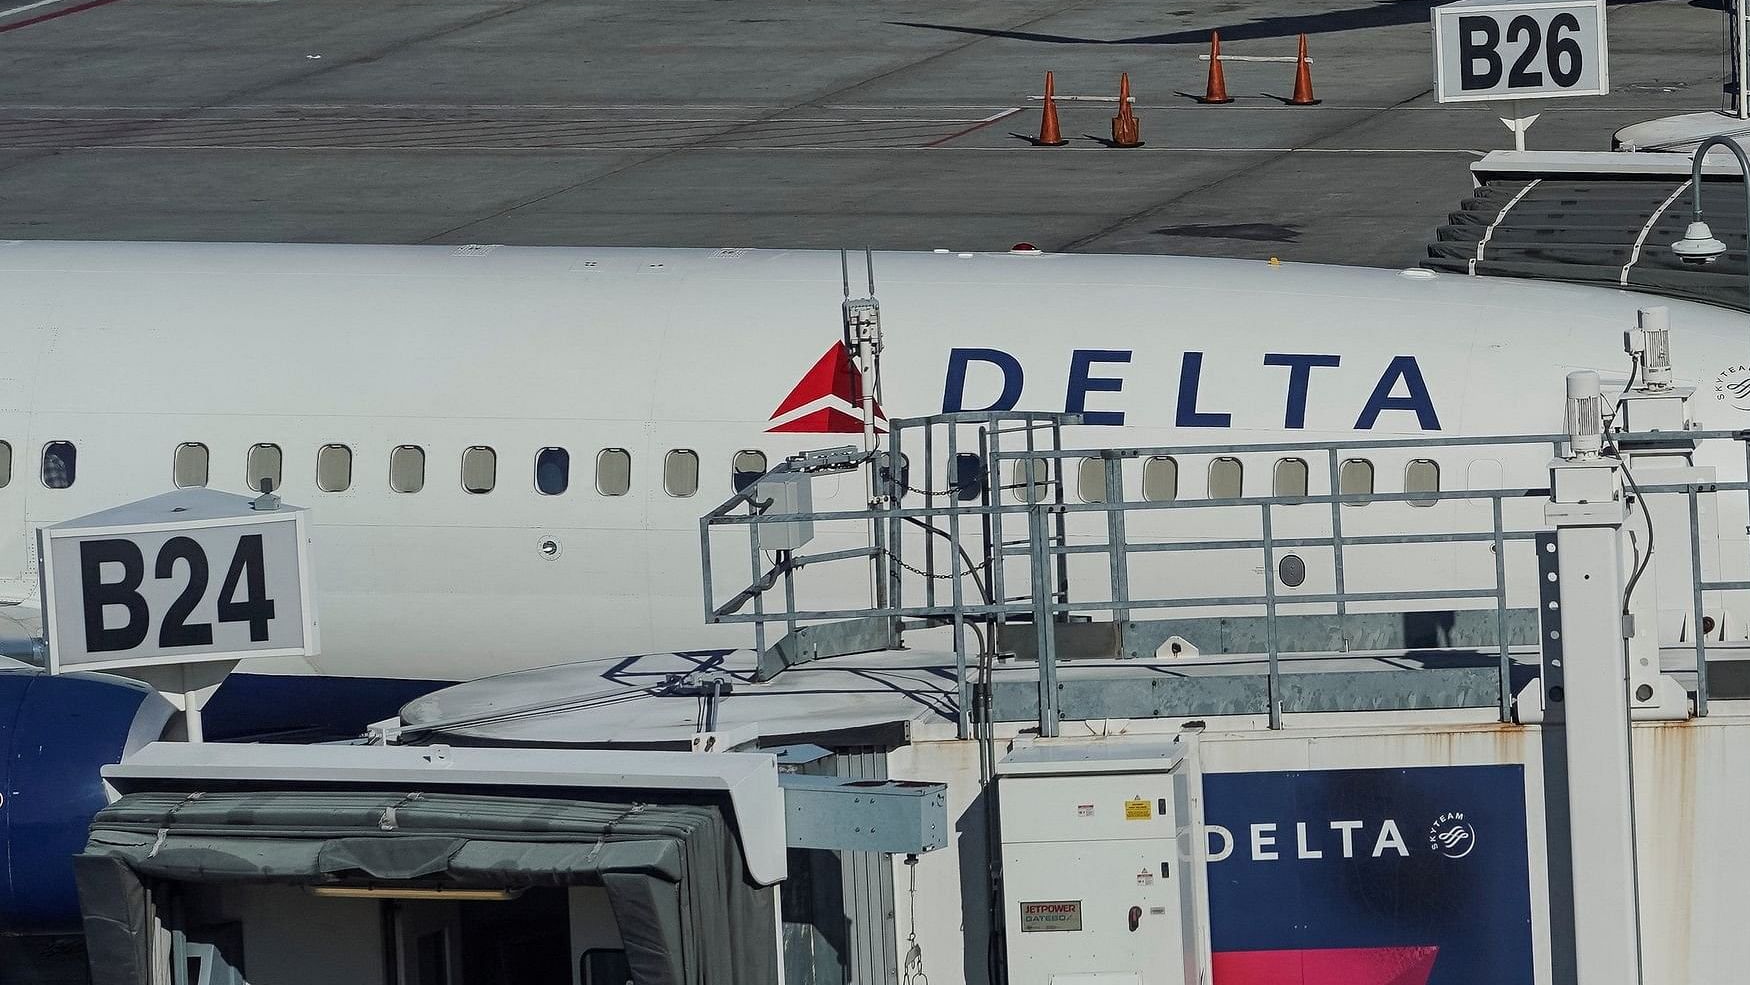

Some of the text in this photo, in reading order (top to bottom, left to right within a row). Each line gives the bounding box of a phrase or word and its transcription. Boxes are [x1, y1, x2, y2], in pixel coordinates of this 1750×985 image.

[1459, 13, 1583, 91] B26
[942, 348, 1442, 431] DELTA
[79, 533, 276, 653] B24
[1204, 819, 1410, 863] DELTA
[1430, 812, 1464, 850] SKYTEAM
[1025, 904, 1077, 914] JETPOWER
